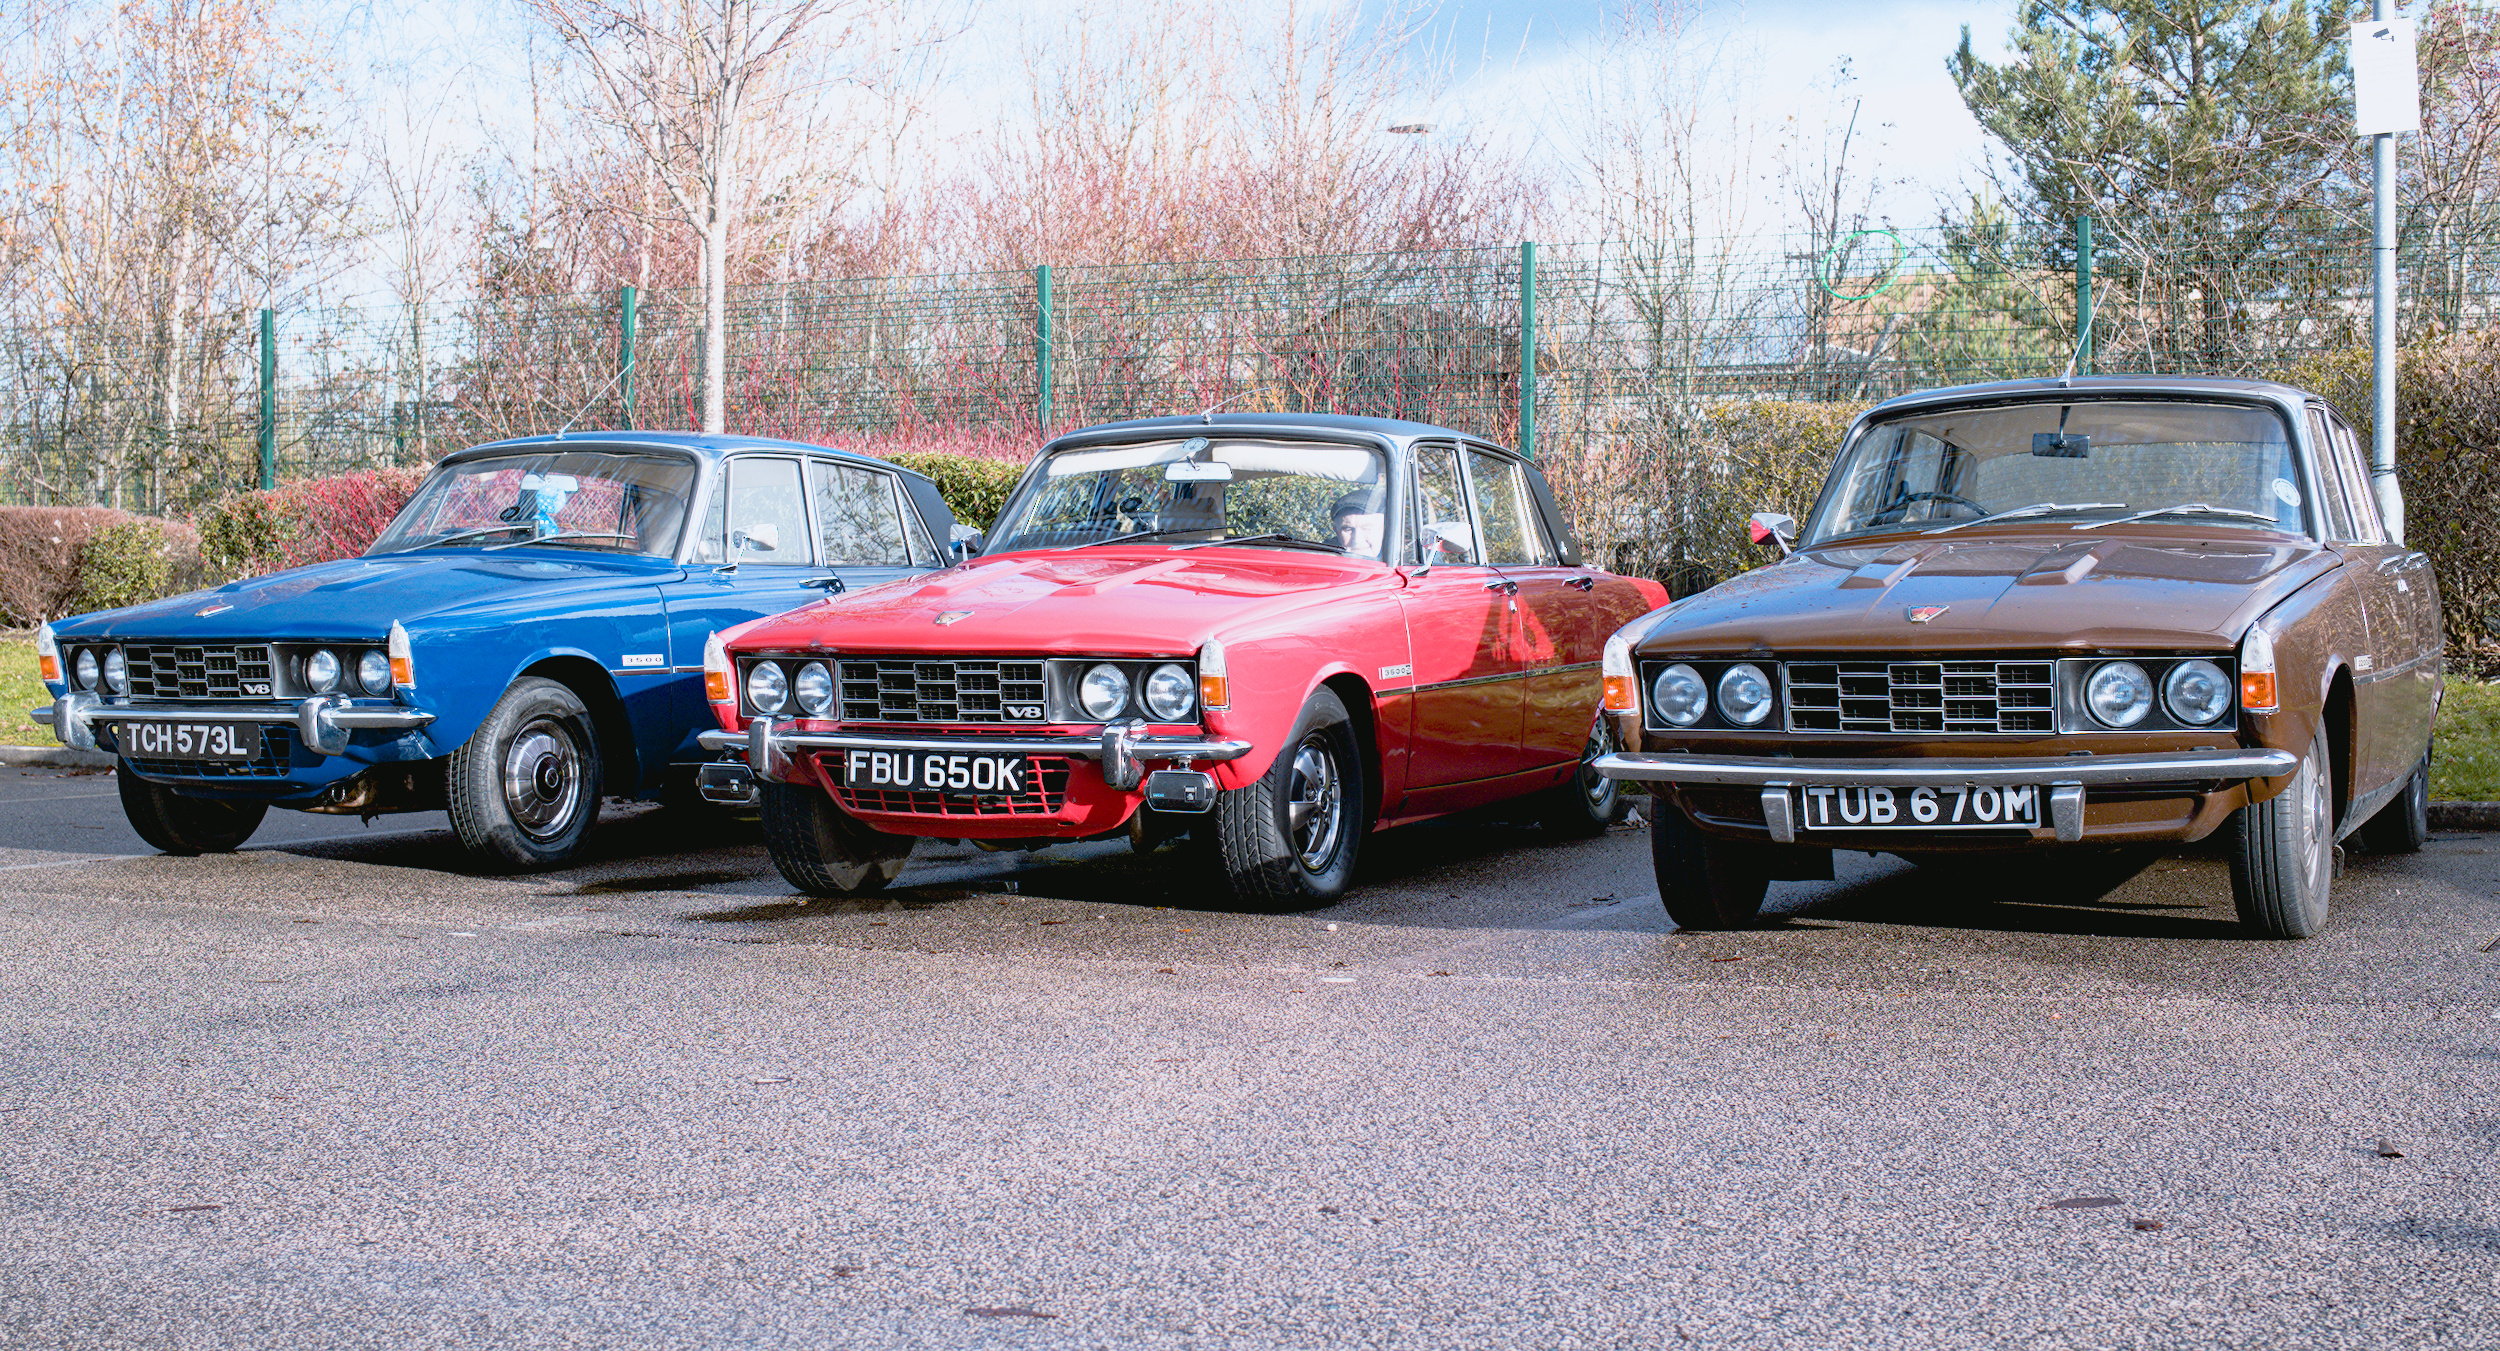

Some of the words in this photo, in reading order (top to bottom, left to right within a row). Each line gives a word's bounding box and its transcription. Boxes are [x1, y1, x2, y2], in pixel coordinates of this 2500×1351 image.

[626, 656, 662, 664] 3500
[243, 684, 271, 695] V8
[1006, 705, 1042, 719] V8
[126, 723, 173, 753] TCH
[176, 724, 248, 755] 573L
[850, 750, 914, 786] FBU
[924, 755, 1021, 791] 650K
[1808, 787, 1898, 824] TUB
[1910, 785, 2034, 823] 670M
